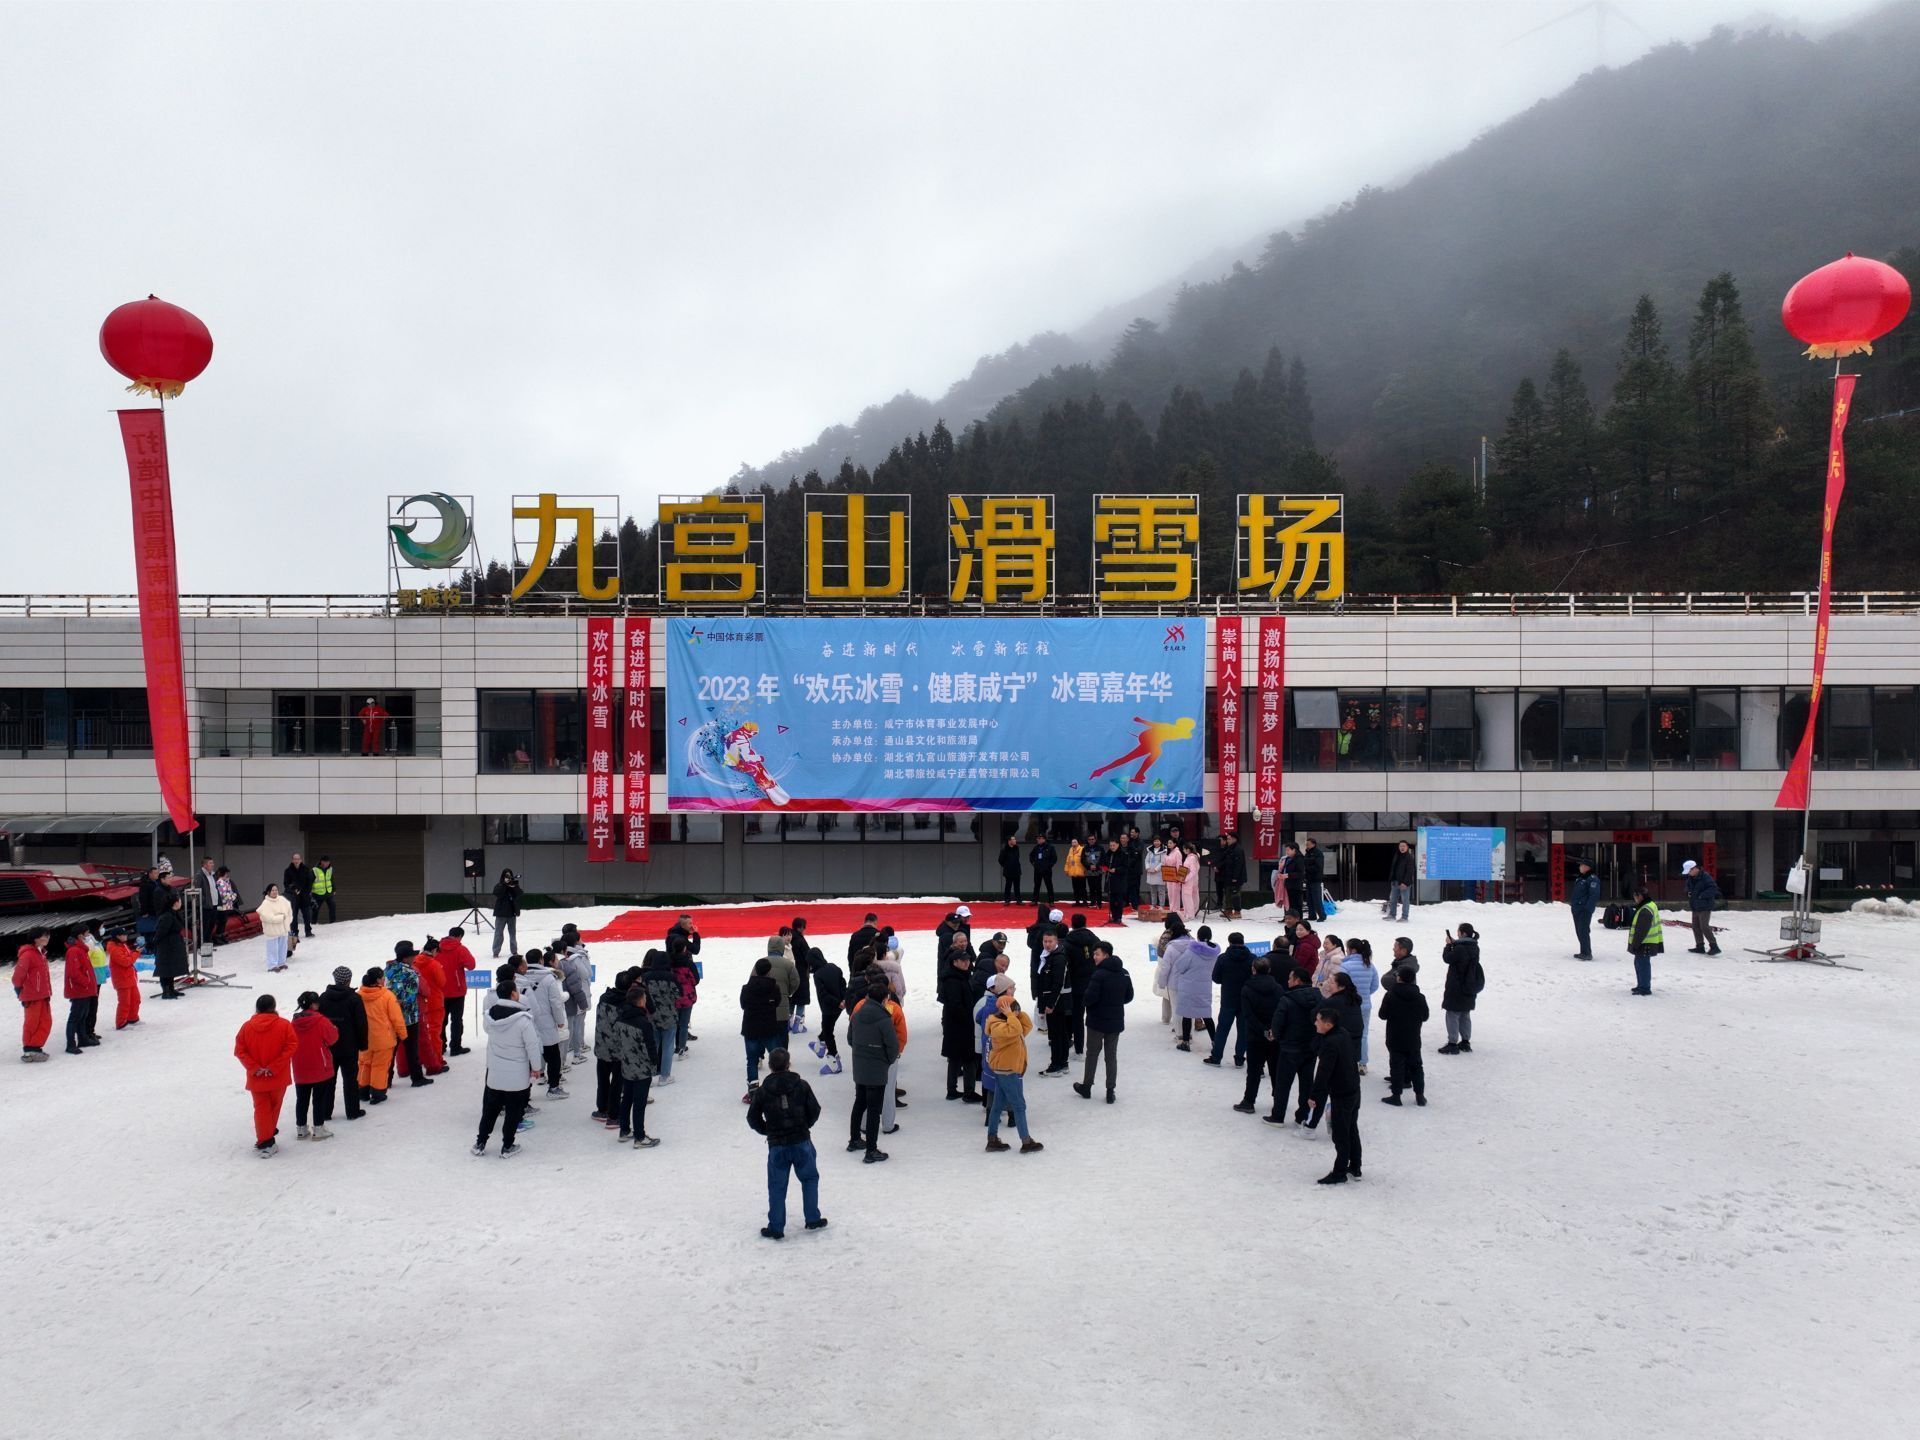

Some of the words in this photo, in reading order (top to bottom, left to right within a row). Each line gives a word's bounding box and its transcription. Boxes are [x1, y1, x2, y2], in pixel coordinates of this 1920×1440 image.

[511, 492, 1345, 602] 九宫山滑雪场
[591, 629, 609, 729] 欢乐冰雪
[628, 628, 646, 729] 奋进新时代
[706, 631, 765, 643] 中国体育彩票
[821, 641, 919, 658] 奋进新时代
[951, 640, 1051, 657] 冰雪新征程
[1221, 628, 1238, 734] 崇尚人人体育
[1261, 628, 1281, 733] 激扬冰雪梦
[1051, 671, 1174, 704] 冰雪嘉年华
[591, 749, 609, 849] 健康咸宁
[628, 750, 646, 849] 冰雪新征程
[1126, 791, 1187, 804] 2023年2月
[1222, 742, 1237, 837] 共创美好生
[1258, 743, 1279, 848] 快乐冰雪行
